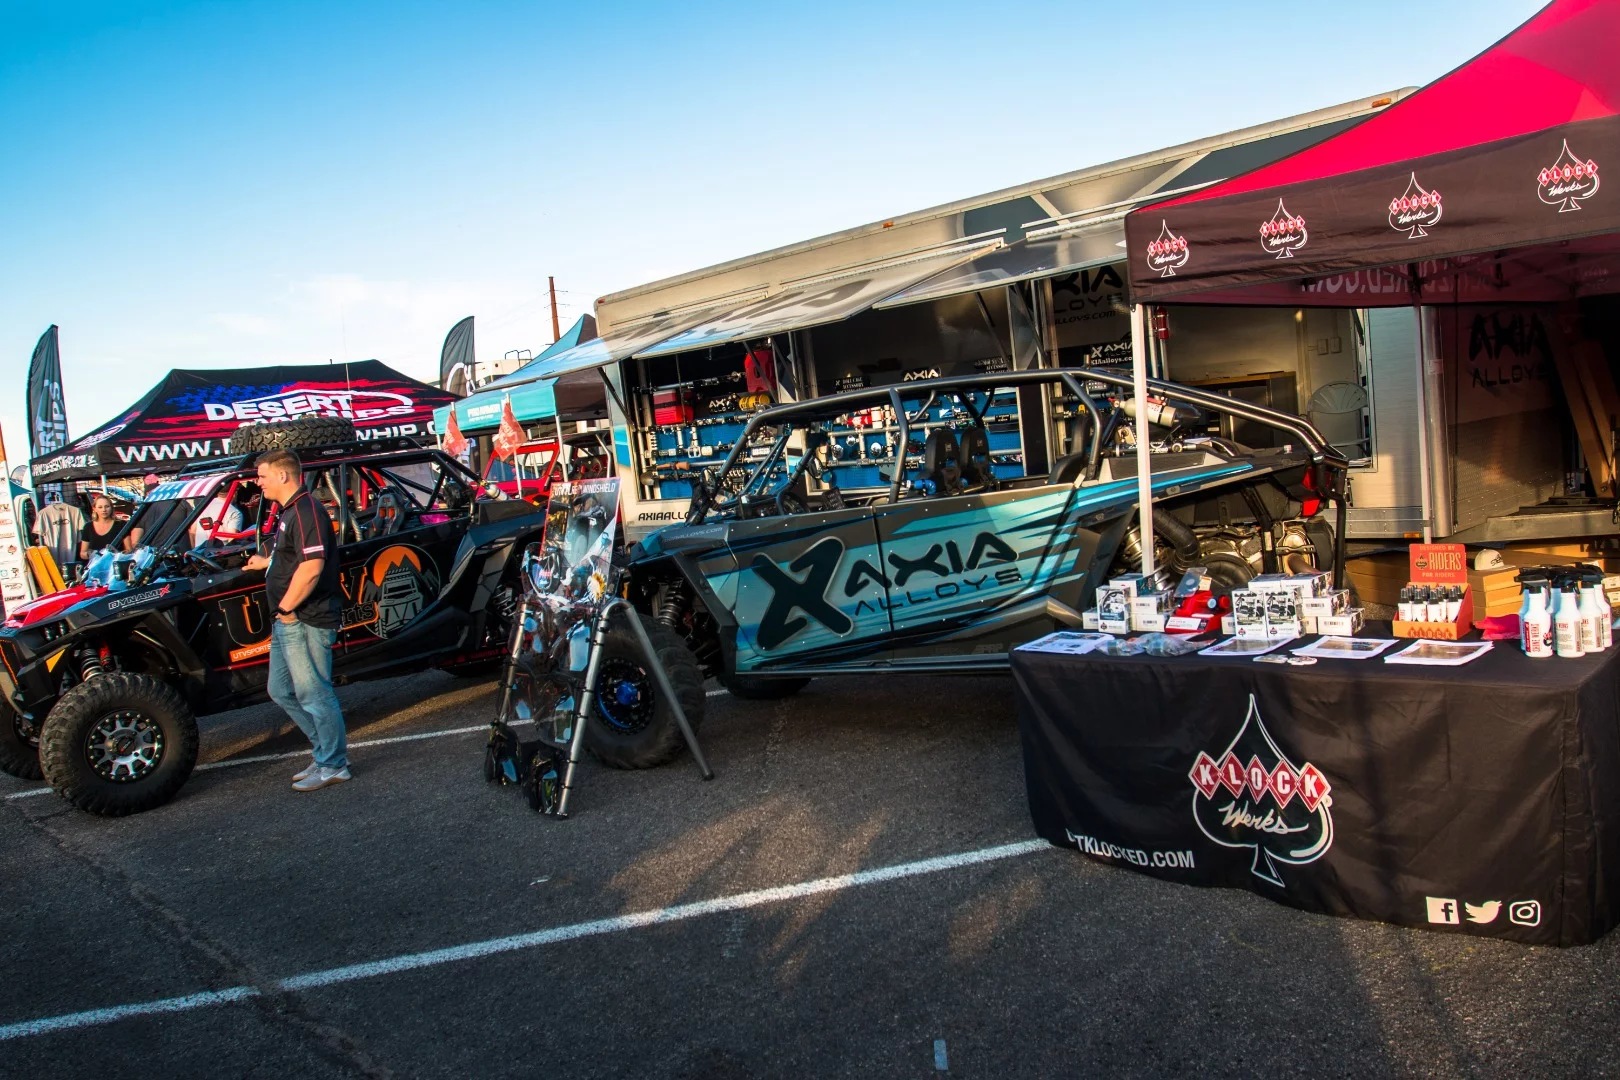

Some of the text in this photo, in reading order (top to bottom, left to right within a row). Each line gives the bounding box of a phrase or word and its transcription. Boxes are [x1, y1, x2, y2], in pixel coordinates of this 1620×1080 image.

[1539, 162, 1596, 184] KLOCK
[1548, 182, 1590, 196] Werks
[1390, 192, 1440, 213] KLOCK
[1261, 217, 1304, 235] KLOCK
[1398, 211, 1434, 225] Werks
[1149, 239, 1186, 255] KLOCK
[1269, 234, 1300, 246] Werks
[1154, 253, 1182, 264] Werks
[903, 369, 939, 382] AXIA
[203, 394, 352, 421] DESERT
[844, 532, 1019, 598] AXIA
[1429, 552, 1462, 570] RIDERS
[108, 584, 172, 610] DYNAMIX
[854, 567, 1021, 617] ALLOYS
[1409, 628, 1452, 638] KLOCK
[1194, 757, 1325, 806] KLOCK
[1218, 800, 1309, 834] Werks
